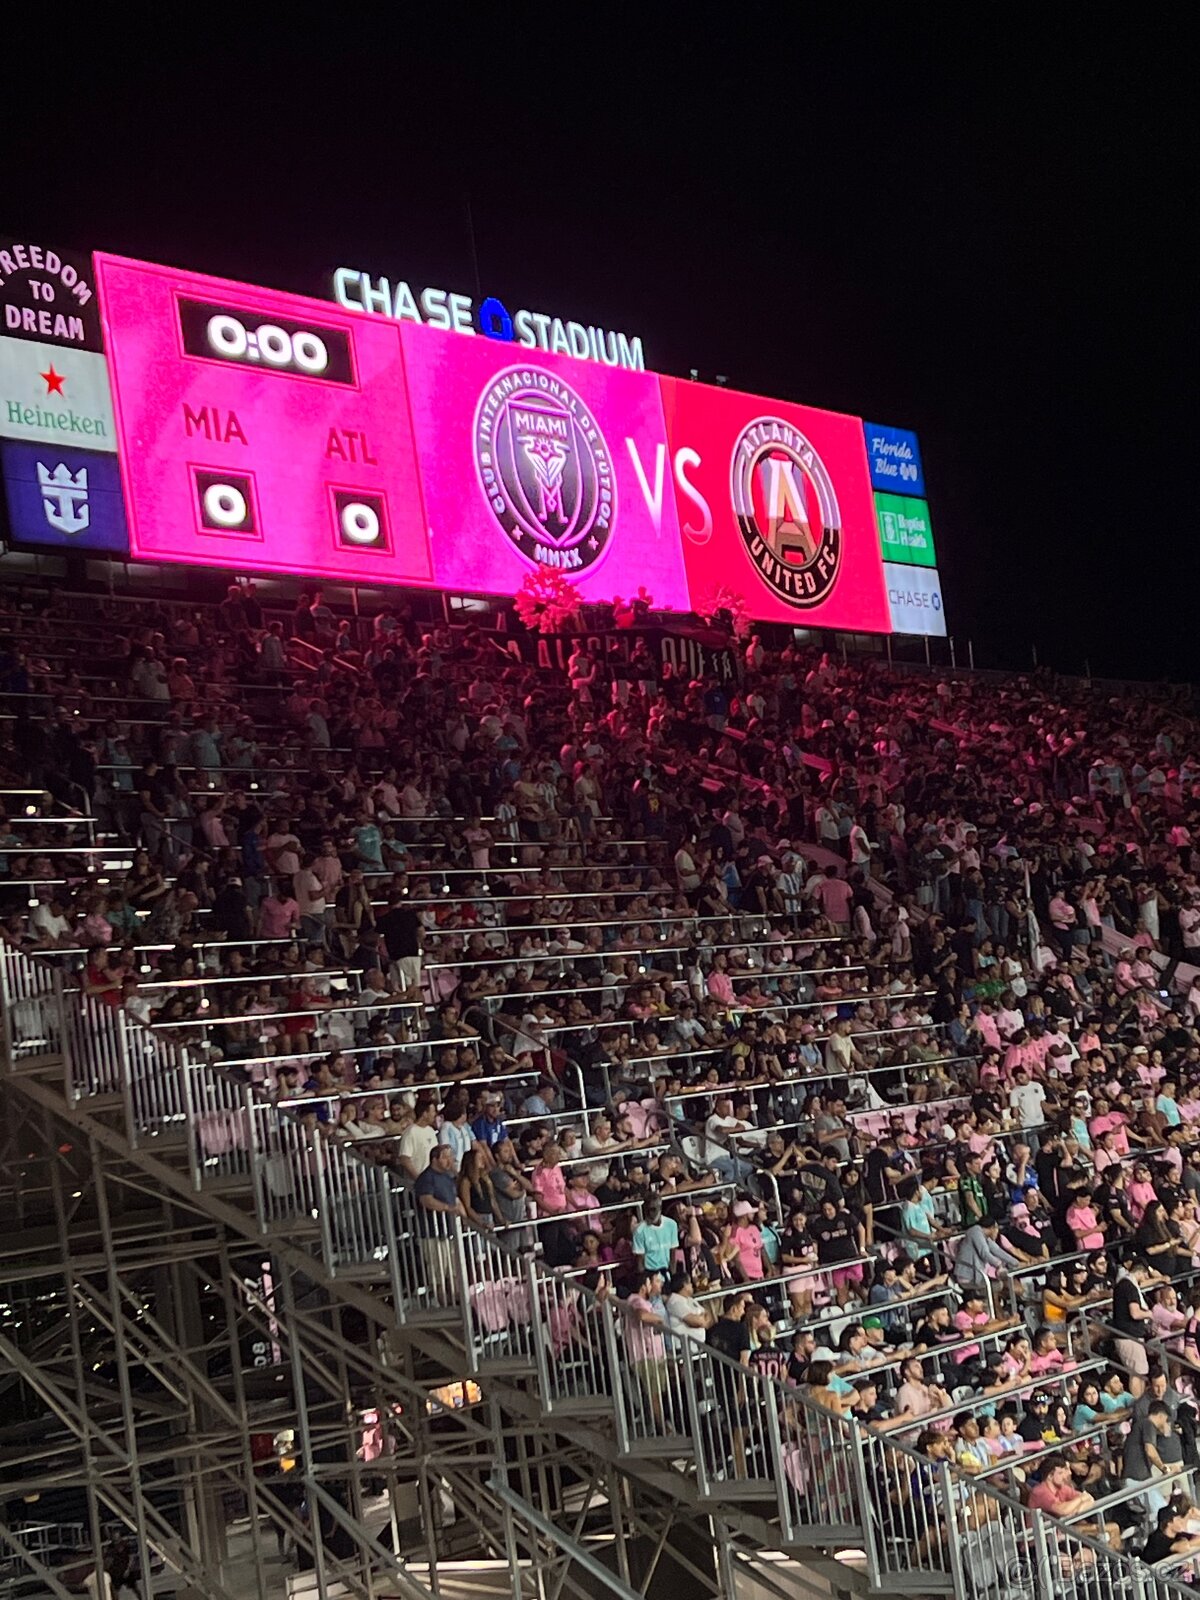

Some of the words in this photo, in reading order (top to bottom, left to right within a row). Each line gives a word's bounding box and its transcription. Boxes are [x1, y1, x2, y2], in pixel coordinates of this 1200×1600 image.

[0, 244, 93, 306] REEDOM
[28, 279, 55, 302] TO
[5, 304, 84, 341] DREAM
[333, 267, 476, 336] CHASE
[515, 309, 645, 372] STADIUM
[207, 314, 328, 372] 0:00
[6, 400, 107, 437] Heineken
[183, 402, 249, 446] MIA
[479, 371, 577, 441] INTERNACIONAL
[515, 413, 567, 435] MIAMI
[325, 427, 378, 466] ATL
[581, 415, 599, 442] DE
[742, 422, 814, 469] ATLANTA
[872, 437, 913, 459] Florida
[480, 452, 506, 514] CLUB
[875, 457, 898, 477] Blue
[204, 483, 246, 525] 0
[625, 437, 713, 545] VS
[341, 502, 379, 543] 0
[534, 543, 583, 568] MMXX
[750, 536, 817, 595] UNITED
[817, 545, 835, 579] FC
[889, 589, 930, 608] CHASE
